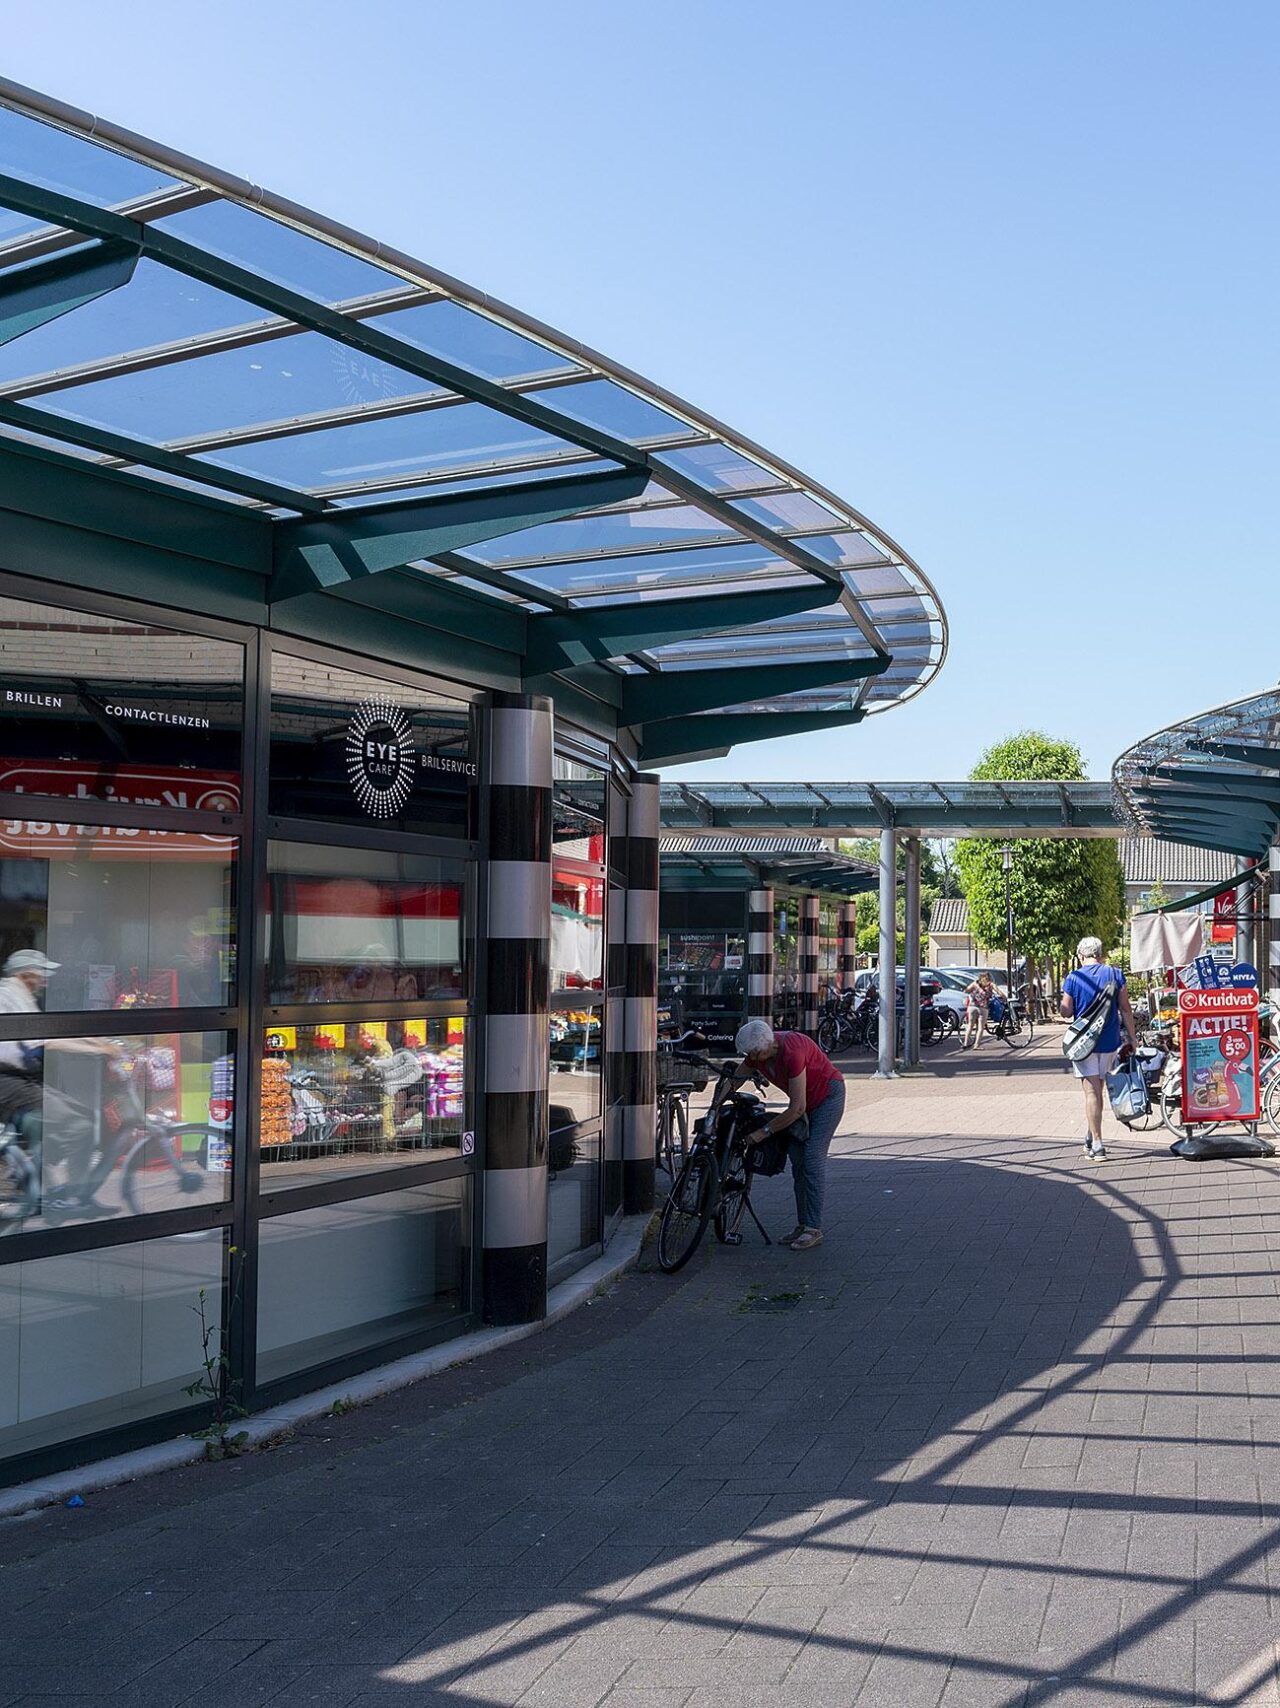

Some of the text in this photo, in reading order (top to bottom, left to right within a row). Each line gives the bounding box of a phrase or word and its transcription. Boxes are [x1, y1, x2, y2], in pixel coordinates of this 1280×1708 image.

[6, 690, 62, 708] BRILLEN
[105, 704, 210, 729] CONTACTLENZEN
[366, 741, 397, 762] EYE
[421, 754, 477, 777] BRILSERVICE
[1198, 992, 1254, 1007] Kruidvat
[1188, 1015, 1248, 1035] ACTIE!
[707, 1034, 734, 1042] Catering
[1066, 1015, 1105, 1061] Babolat
